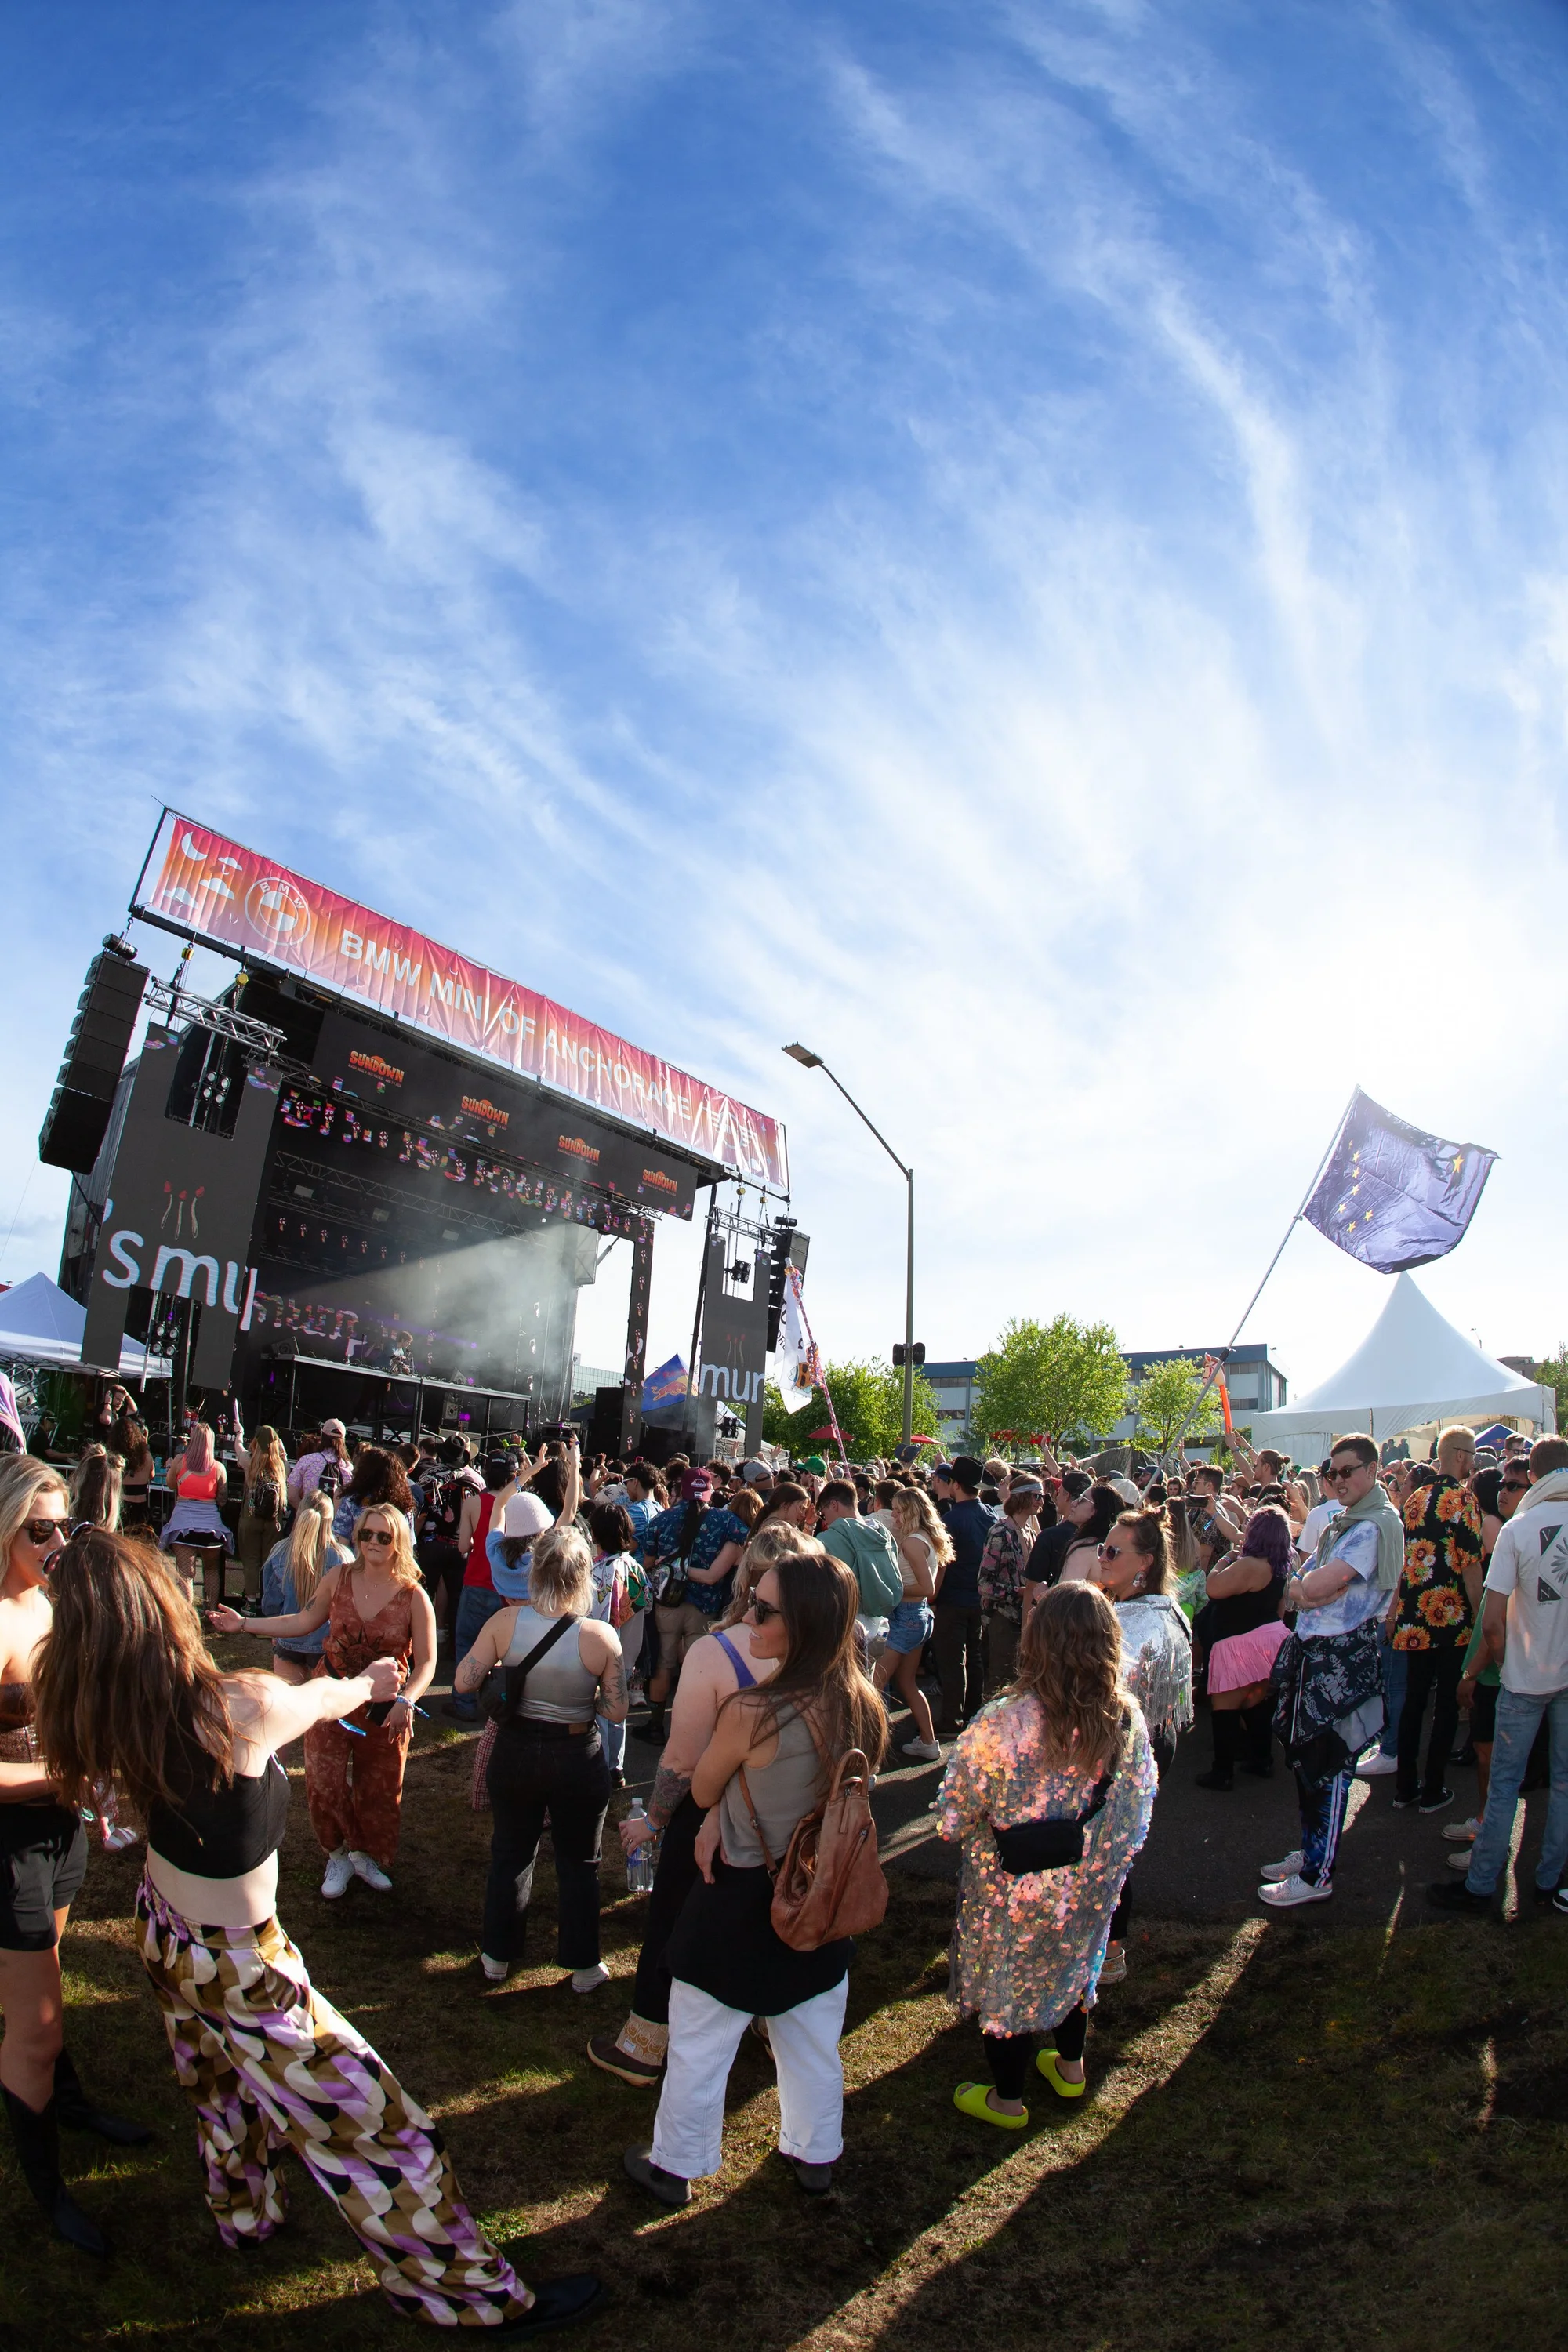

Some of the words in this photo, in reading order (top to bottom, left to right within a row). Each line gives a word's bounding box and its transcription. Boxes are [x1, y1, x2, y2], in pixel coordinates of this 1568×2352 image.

[259, 881, 305, 909] BMW
[339, 928, 422, 987] BMW
[499, 1007, 537, 1040] OF
[545, 1028, 691, 1121] ANCHORAGE
[349, 1051, 405, 1082] SUNDOWN
[461, 1095, 510, 1125] SUNDOWN
[558, 1134, 601, 1161] SUNDOWN
[642, 1169, 678, 1192] SUNDOWN
[699, 1363, 765, 1403] mur
[1541, 1529, 1552, 1541] V
[1540, 1587, 1551, 1600] N
